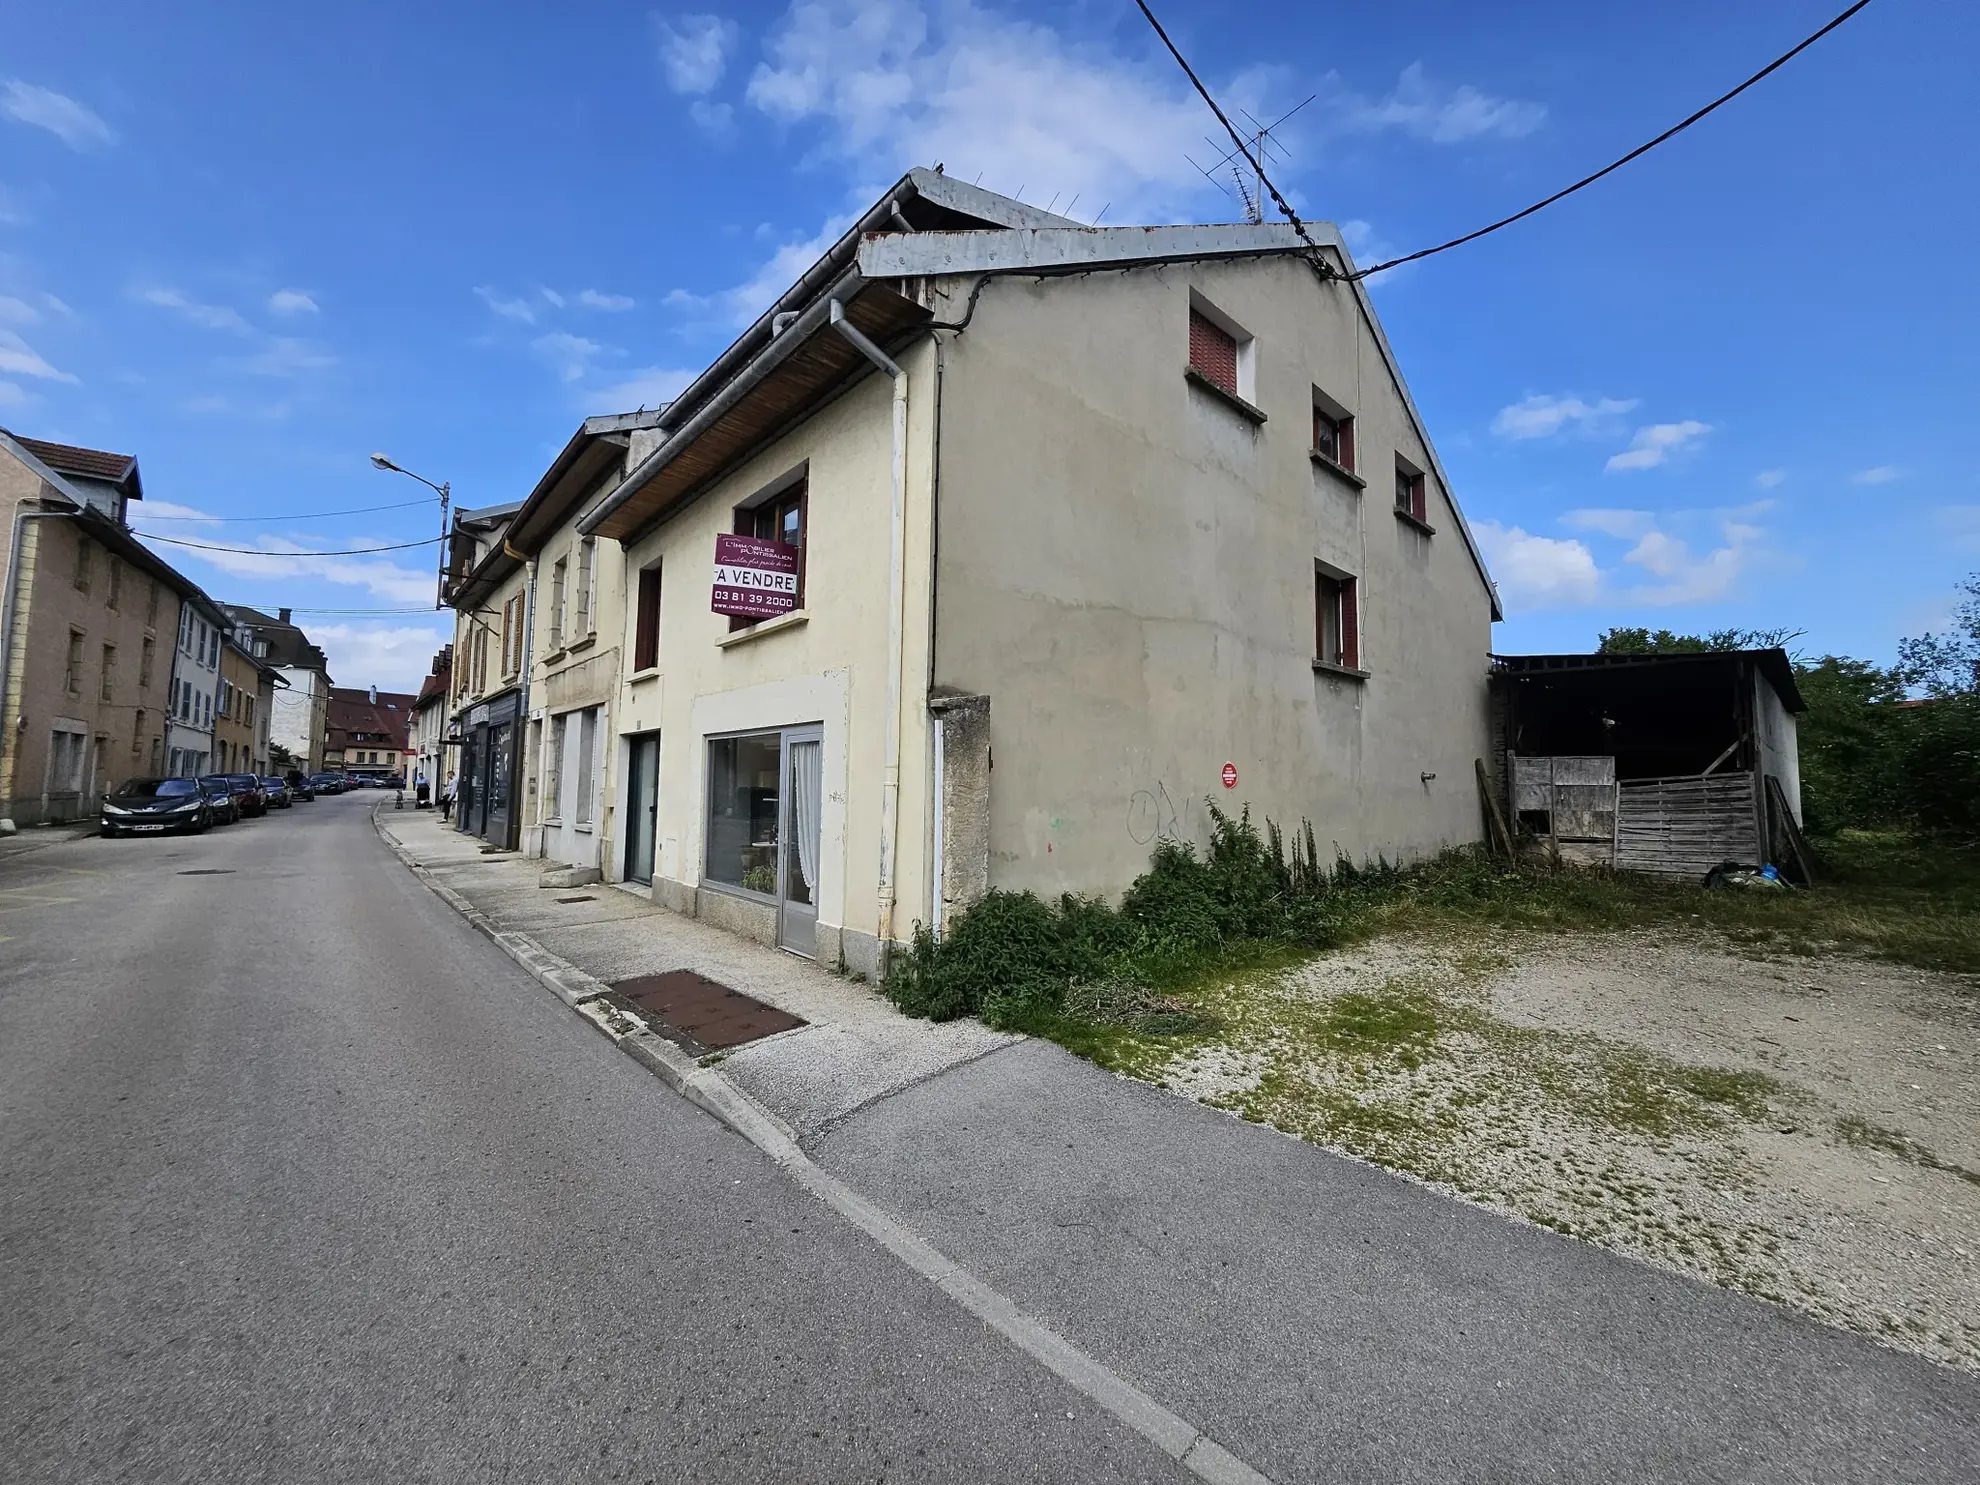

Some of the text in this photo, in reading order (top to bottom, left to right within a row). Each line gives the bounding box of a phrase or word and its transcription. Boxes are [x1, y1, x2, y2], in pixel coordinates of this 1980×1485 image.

[725, 541, 775, 553] L'IMMOBILIER
[740, 548, 793, 561] PONTISSALIEN
[732, 569, 793, 590] VENDRE
[715, 591, 792, 607] 03 81 39 2000
